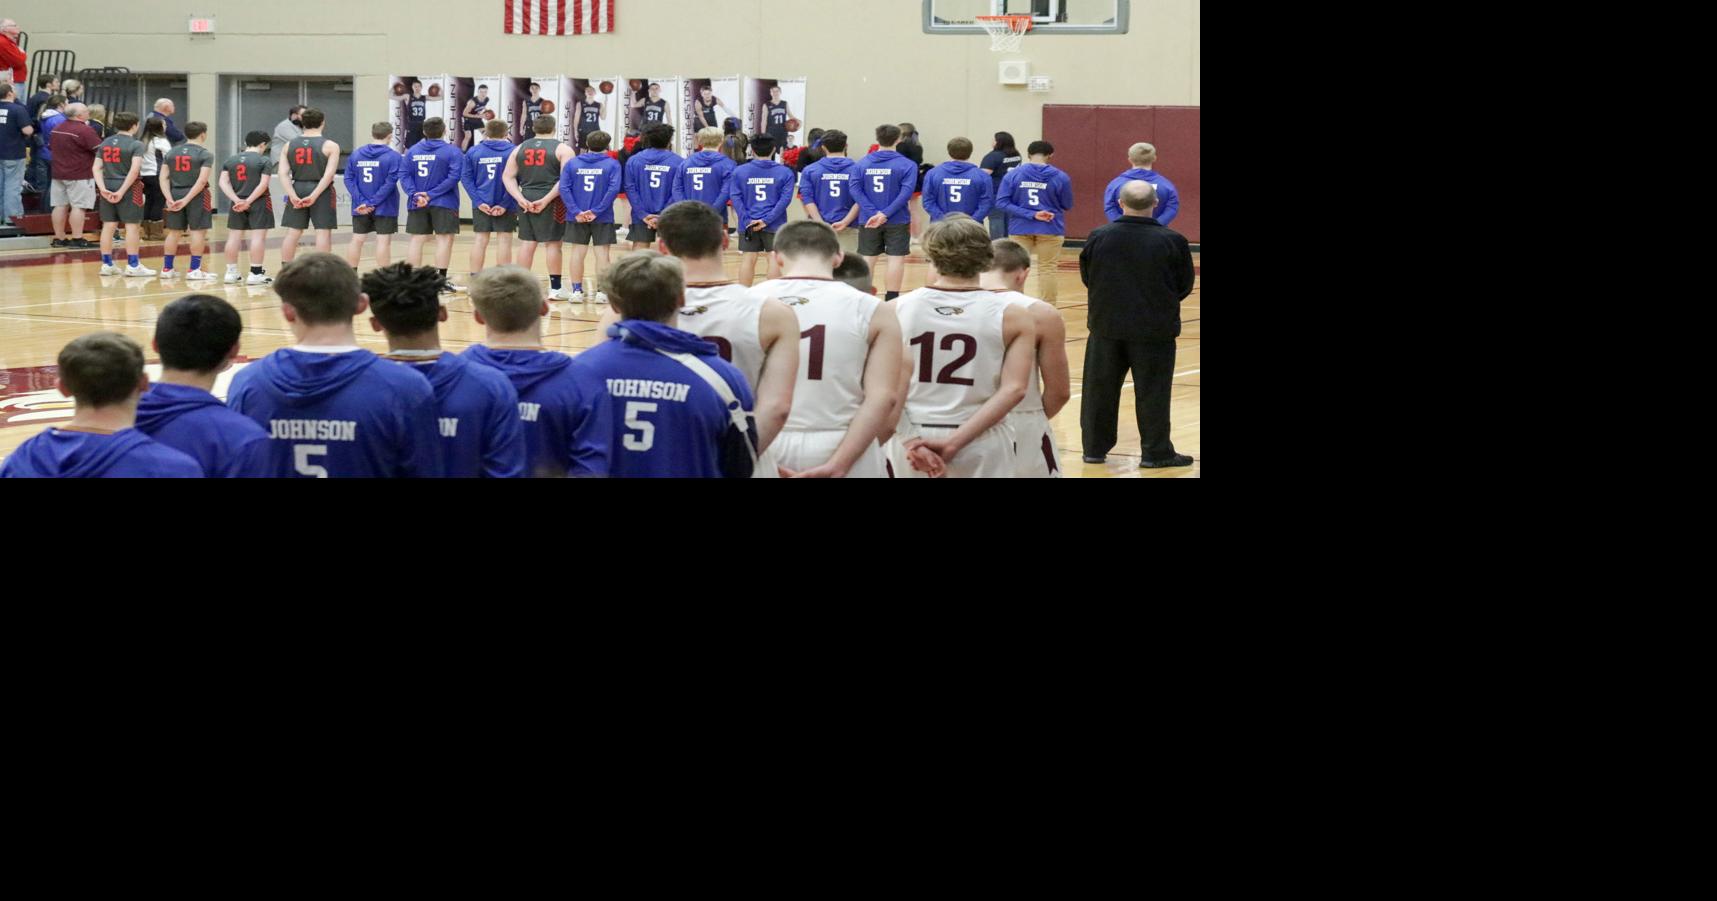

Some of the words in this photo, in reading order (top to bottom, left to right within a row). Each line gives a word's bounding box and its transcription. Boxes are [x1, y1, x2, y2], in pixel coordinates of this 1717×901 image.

[412, 107, 424, 116] 32
[586, 113, 597, 122] 21
[647, 112, 659, 121] 31
[103, 146, 121, 162] 22
[295, 147, 313, 164] 21
[524, 148, 546, 166] 33
[175, 155, 192, 171] 15
[418, 161, 429, 177] 5
[236, 164, 247, 181] 2
[363, 167, 373, 183] 5
[486, 164, 496, 180] 5
[649, 172, 661, 188] 5
[583, 175, 595, 192] 5
[693, 174, 703, 190] 5
[829, 180, 840, 197] 5
[873, 175, 884, 193] 5
[755, 184, 766, 201] 5
[950, 185, 962, 203] 5
[1028, 189, 1040, 206] 5
[800, 324, 826, 380] 1
[909, 331, 979, 386] 12
[605, 379, 691, 402] JOHNSON
[268, 419, 356, 441] JOHNSON
[623, 402, 658, 452] 5
[294, 444, 328, 478] 5
